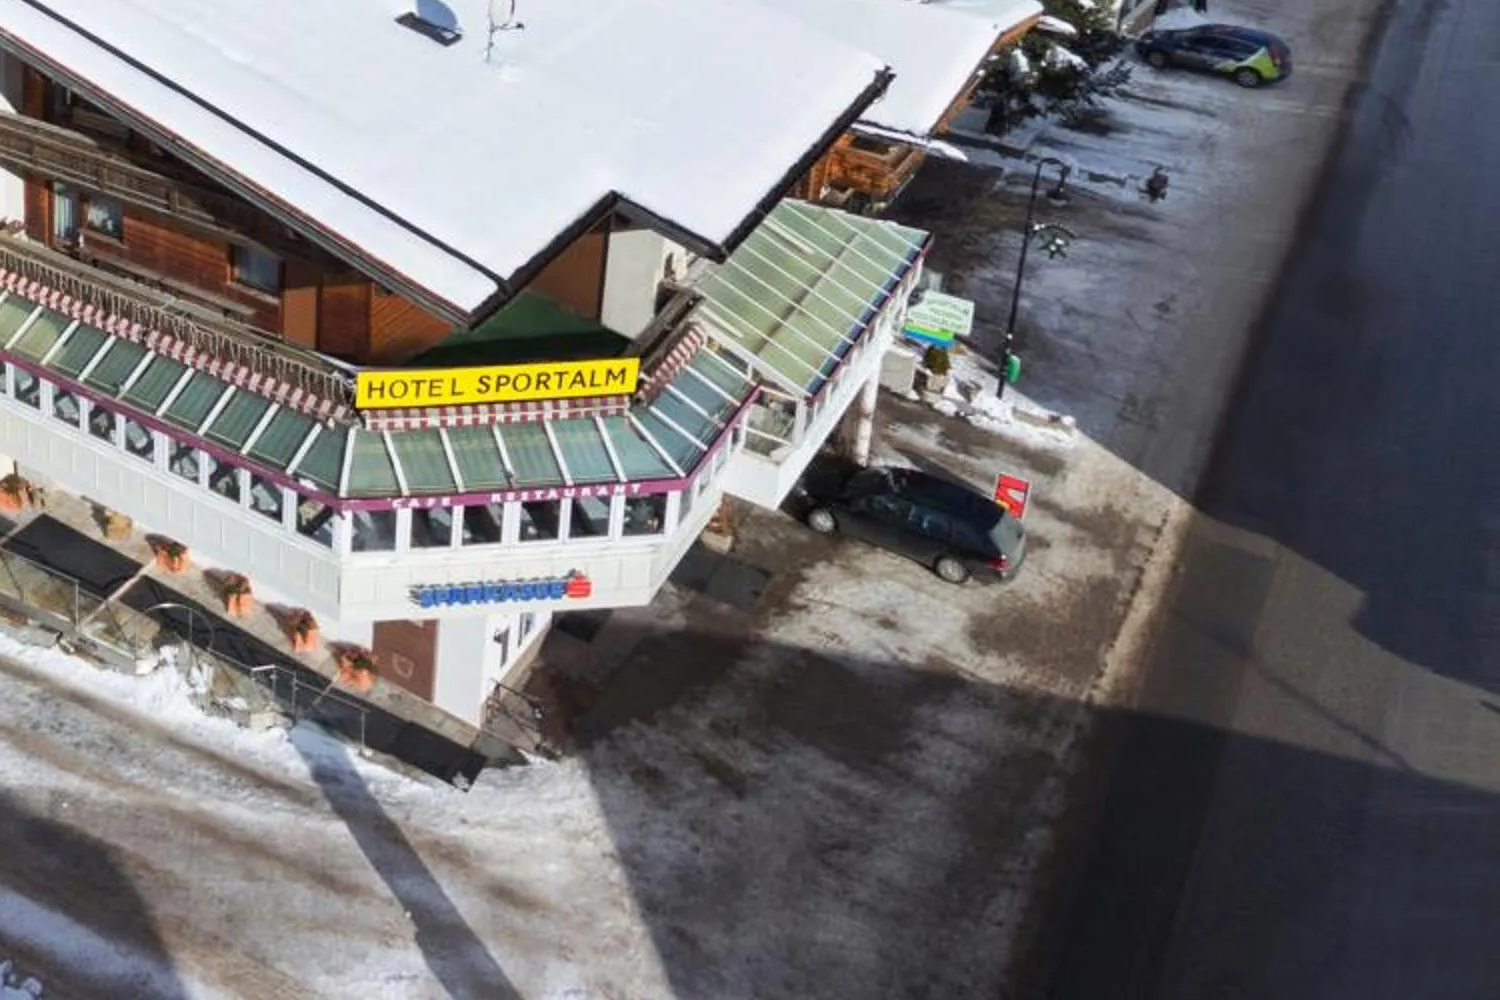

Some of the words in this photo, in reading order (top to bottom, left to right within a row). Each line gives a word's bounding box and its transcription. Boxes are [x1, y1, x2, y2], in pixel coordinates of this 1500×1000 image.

[367, 378, 465, 400] HOTEL
[476, 367, 627, 395] SPORTALM
[491, 483, 641, 503] RESTAURANT
